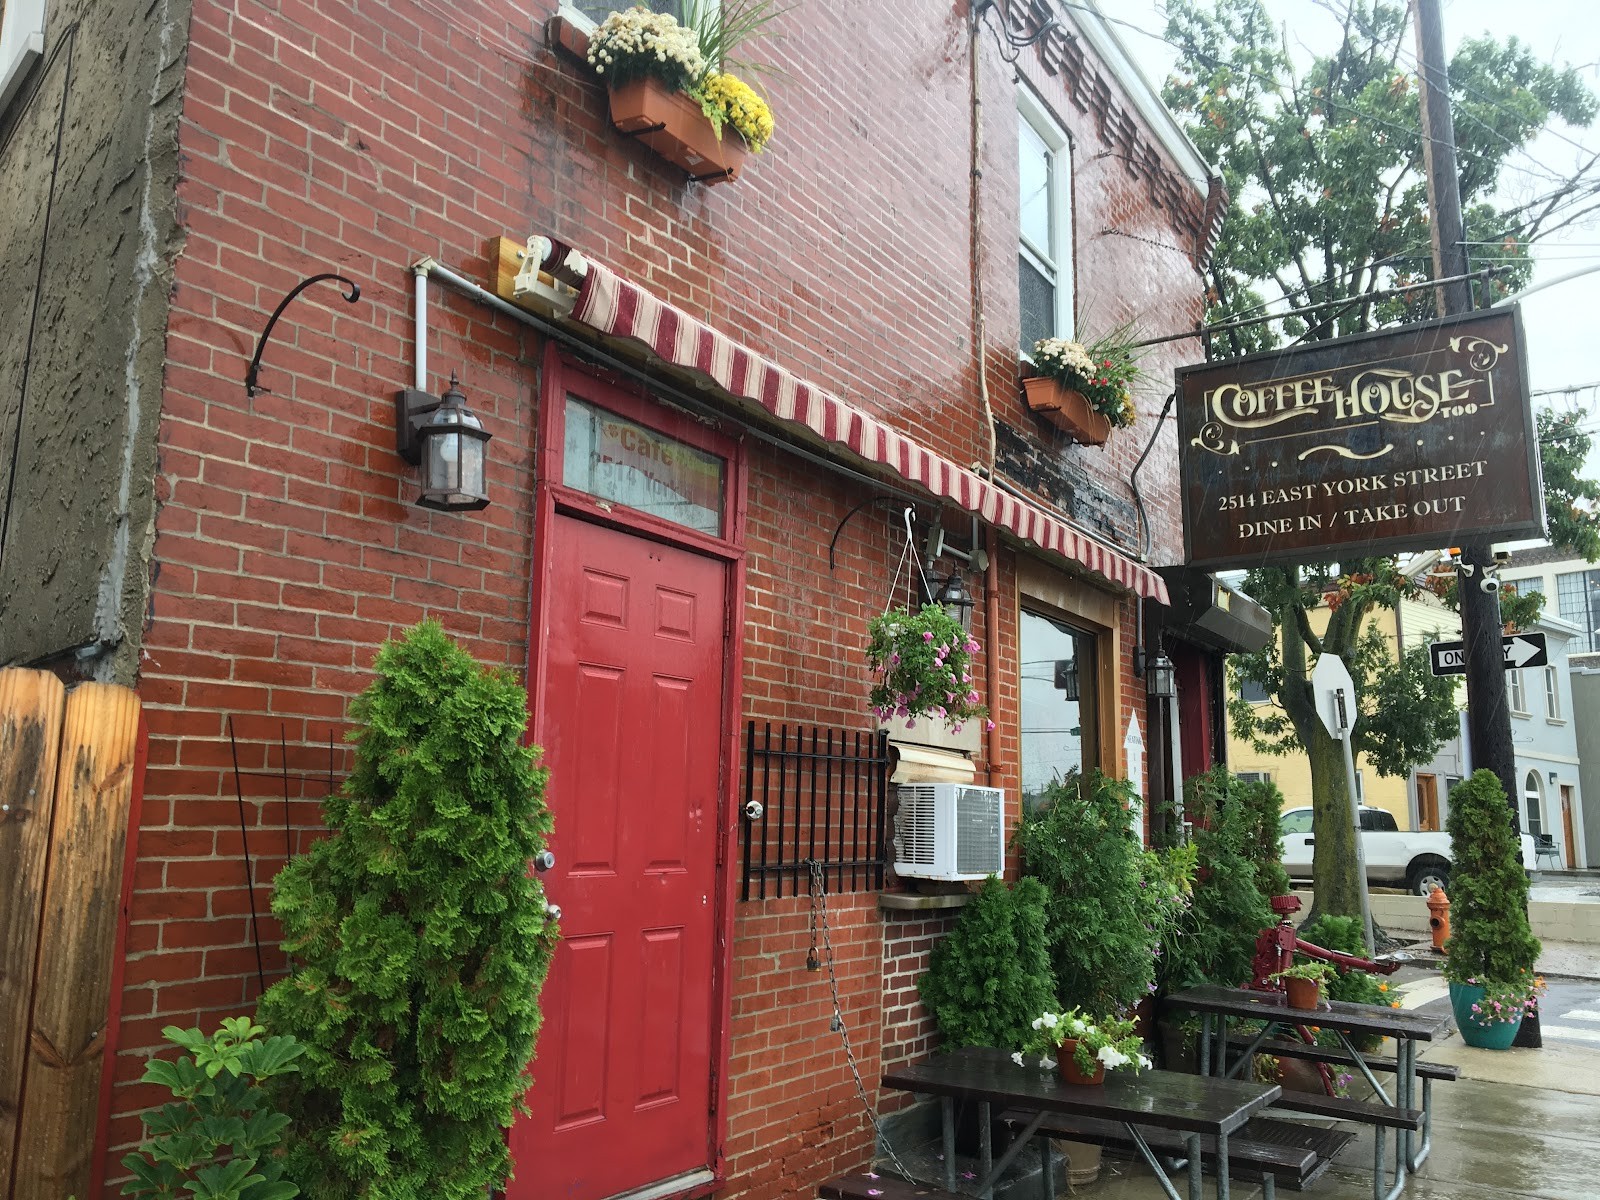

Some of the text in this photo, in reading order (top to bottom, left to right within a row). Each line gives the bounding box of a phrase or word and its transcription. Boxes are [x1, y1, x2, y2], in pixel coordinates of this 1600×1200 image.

[1212, 368, 1484, 429] COFFEE HOUSE
[1218, 460, 1488, 512] 2514 EAST YORK STREET
[1237, 517, 1294, 539] DINE
[1298, 513, 1323, 532] IN
[1343, 502, 1409, 526] TAKE
[1413, 495, 1467, 517] OUT
[1444, 650, 1466, 665] ON
